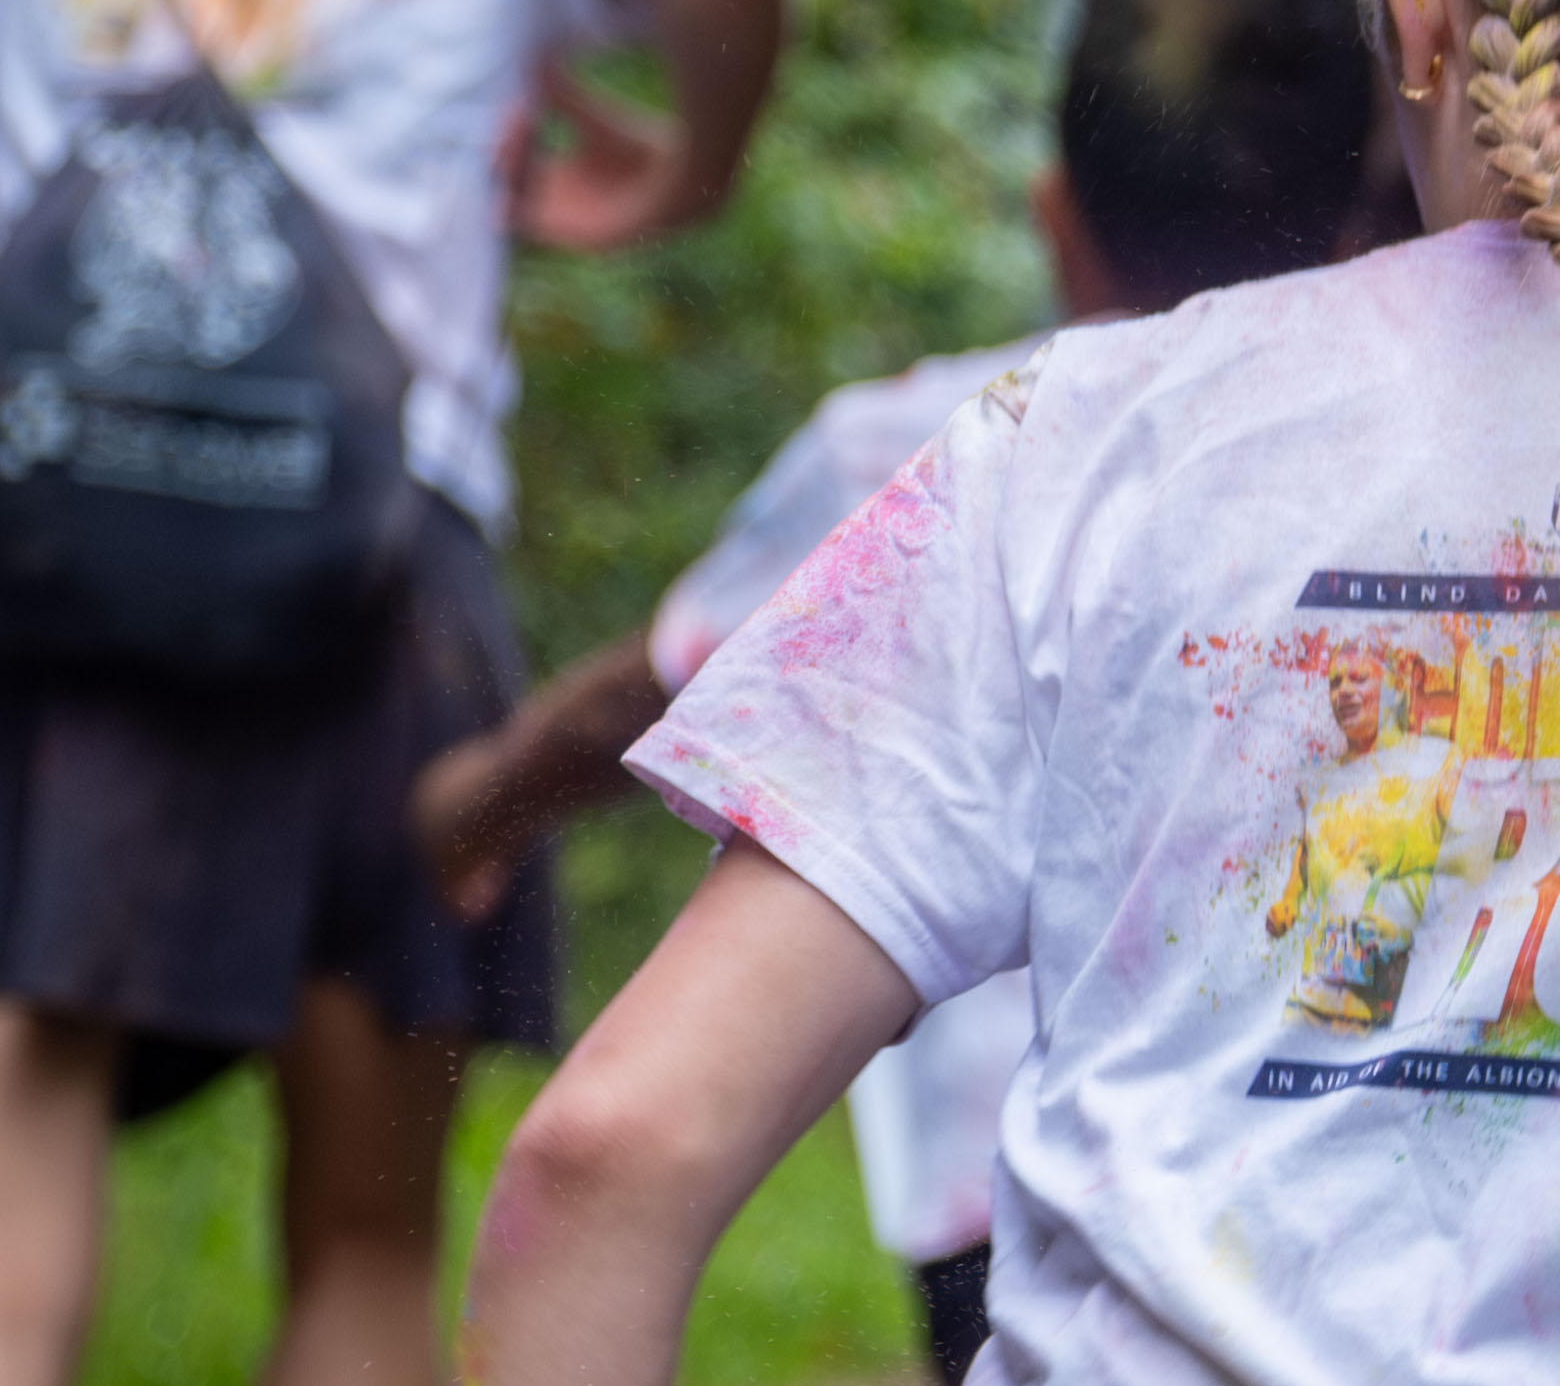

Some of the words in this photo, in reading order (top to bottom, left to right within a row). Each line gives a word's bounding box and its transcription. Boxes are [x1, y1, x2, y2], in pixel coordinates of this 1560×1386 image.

[1349, 581, 1465, 606] BLIND
[1268, 1068, 1294, 1092] IN
[1309, 1070, 1349, 1093] AID
[1357, 1059, 1385, 1080] OF
[1401, 1058, 1448, 1081] THE
